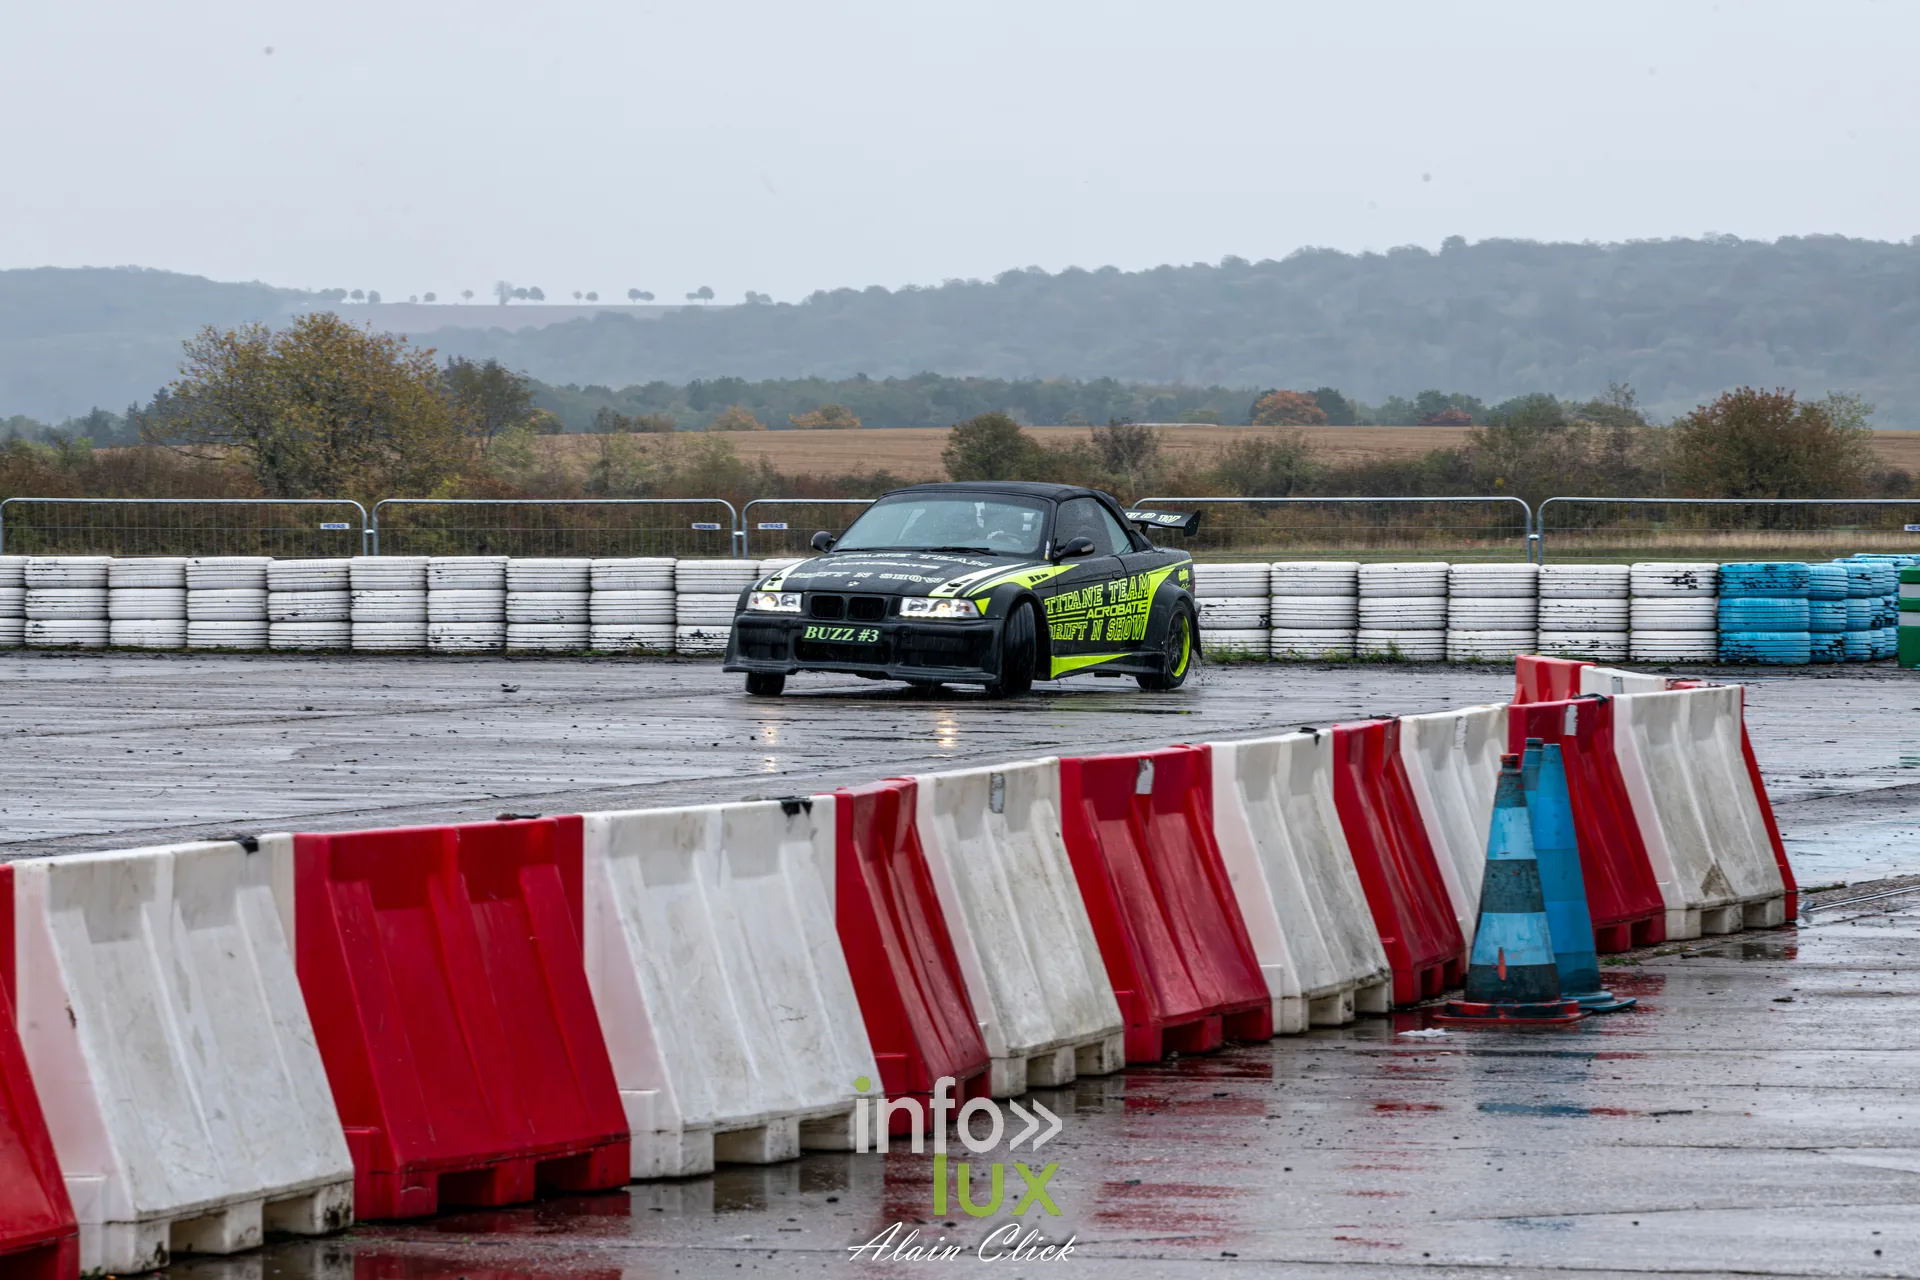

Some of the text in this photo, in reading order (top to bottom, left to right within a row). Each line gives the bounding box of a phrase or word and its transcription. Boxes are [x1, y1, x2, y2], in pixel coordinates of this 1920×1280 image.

[879, 573, 946, 583] SHOW
[1044, 584, 1103, 614] TITANE
[1108, 573, 1150, 603] TEAM
[1086, 602, 1148, 619] ACROBATE
[804, 626, 879, 642] BUZZ #3
[1091, 620, 1103, 640] N
[1106, 614, 1146, 641] SHOW
